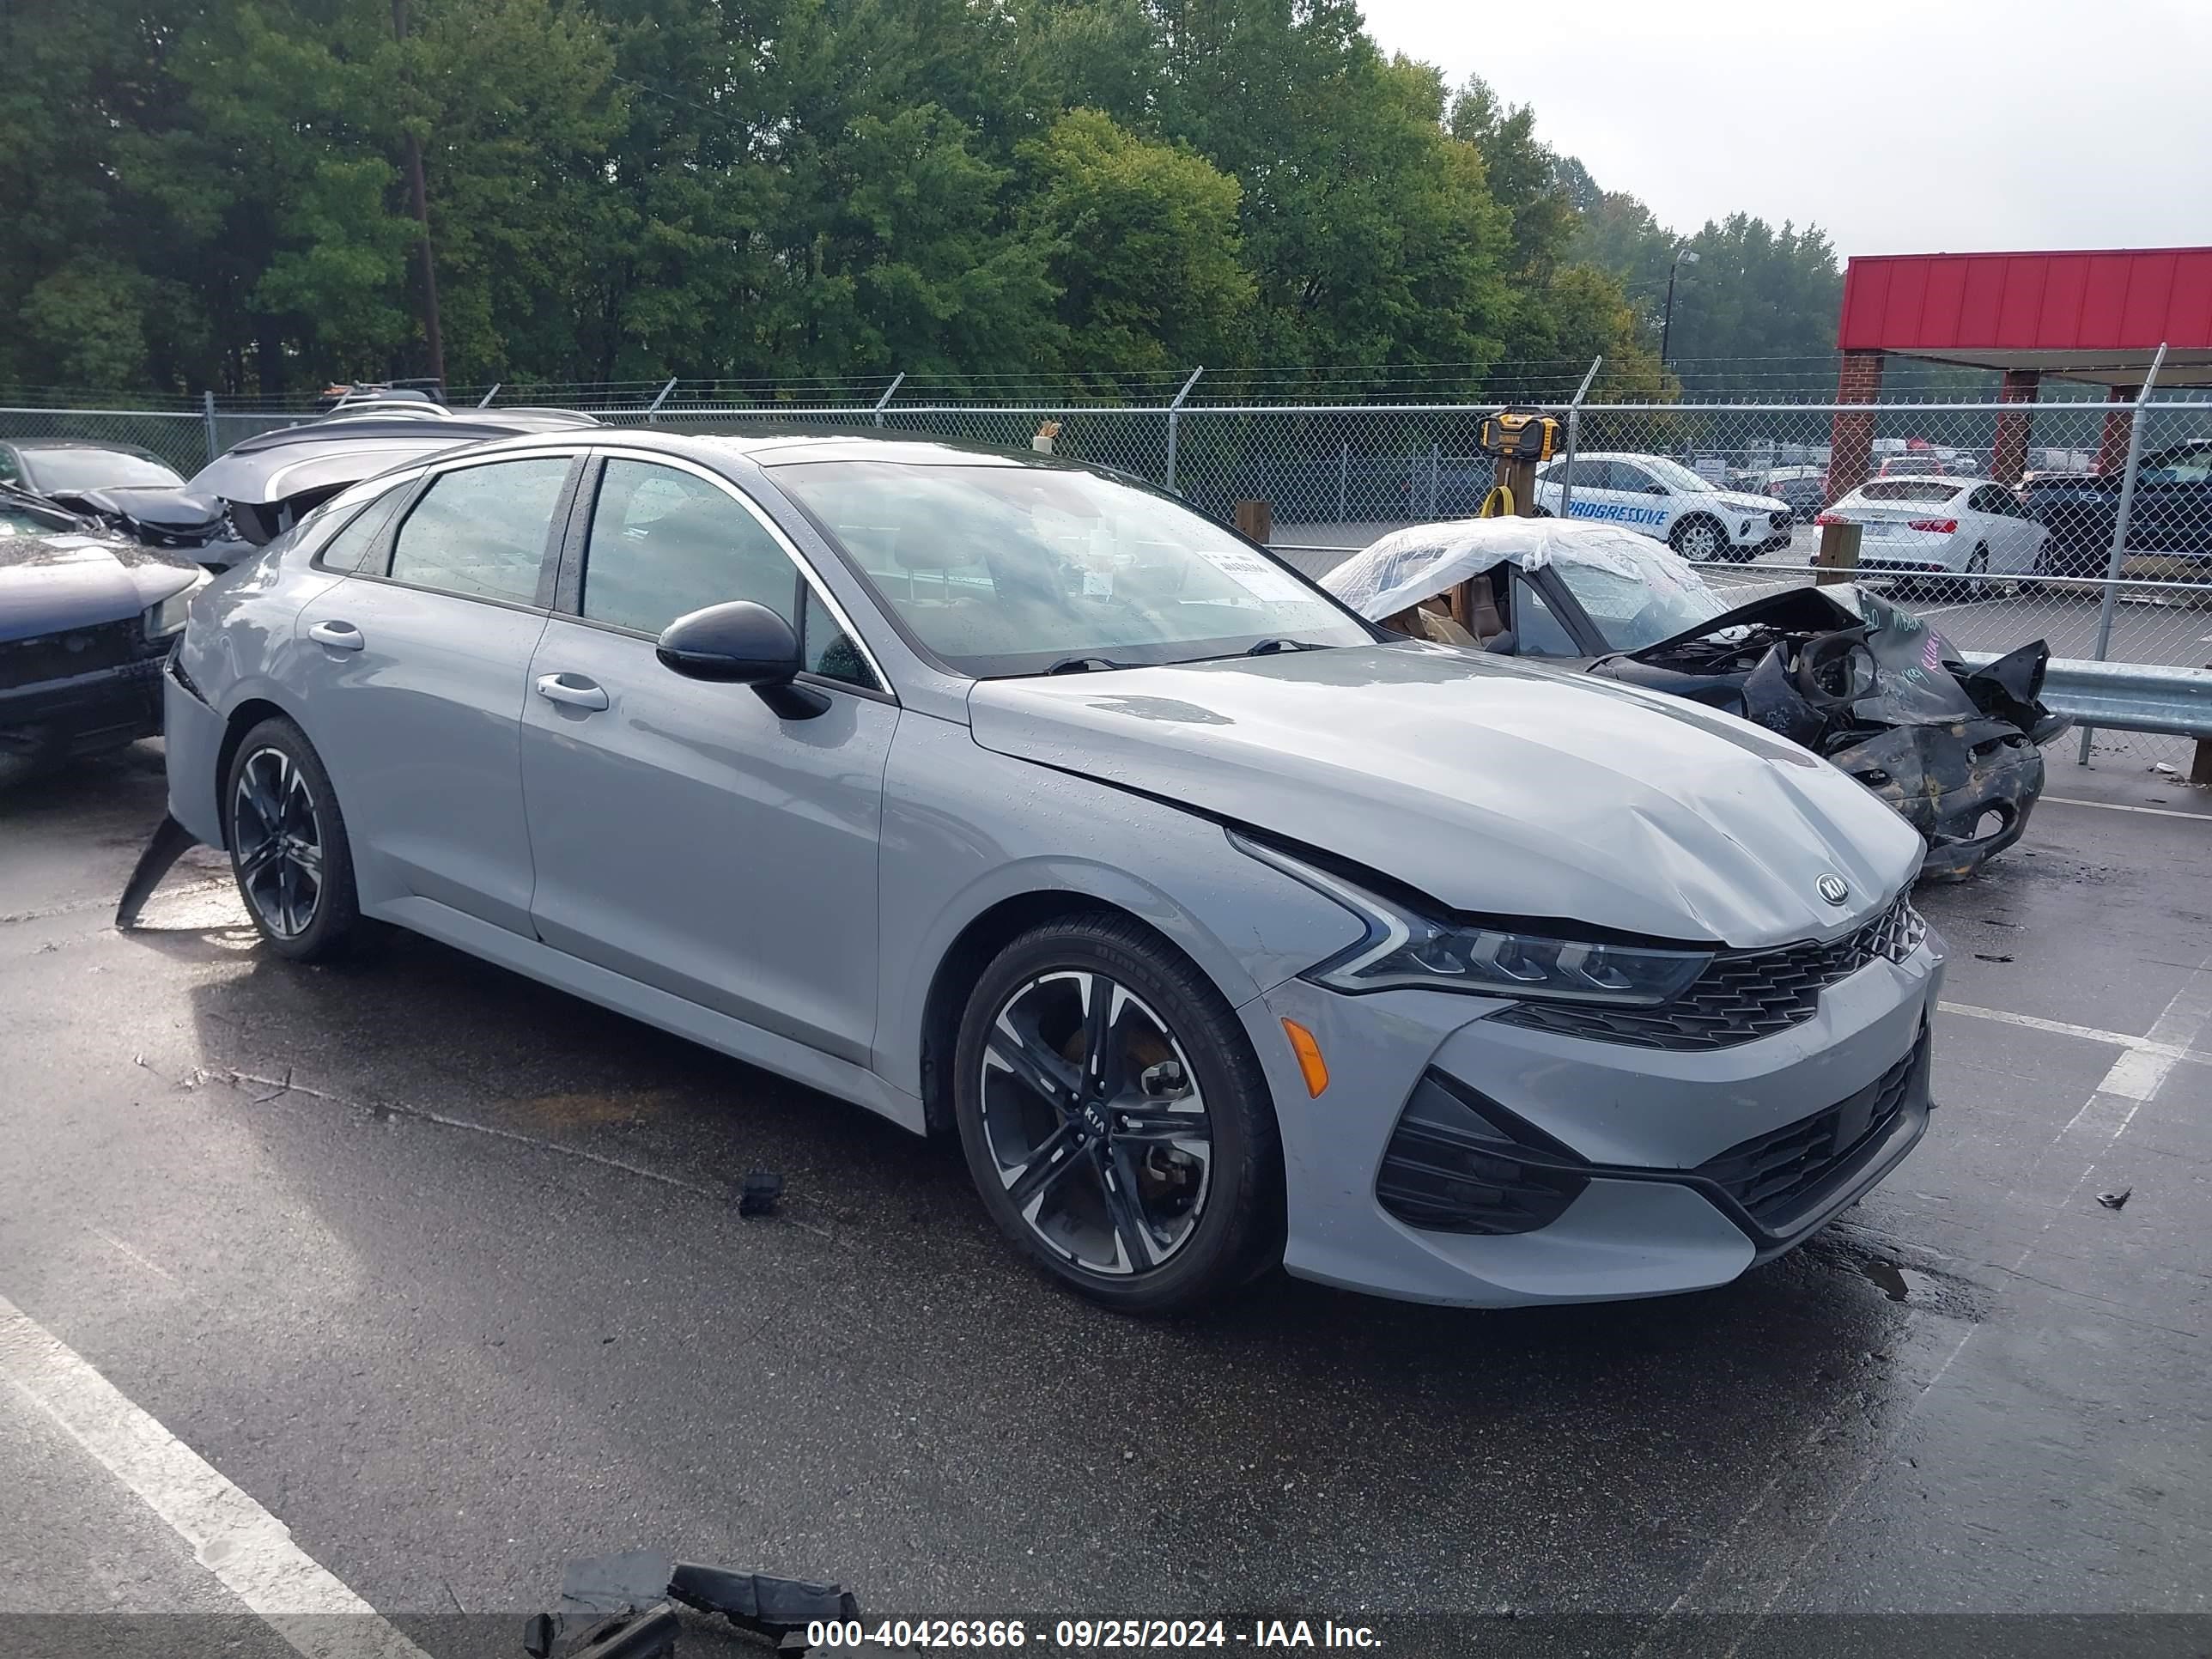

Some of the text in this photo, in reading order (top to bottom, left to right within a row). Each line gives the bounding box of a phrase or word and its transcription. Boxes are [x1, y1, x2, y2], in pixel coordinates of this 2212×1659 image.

[1568, 501, 1669, 526] PROGRESSIVE
[1820, 877, 1849, 899] KIA
[1085, 1106, 1105, 1132] KIA
